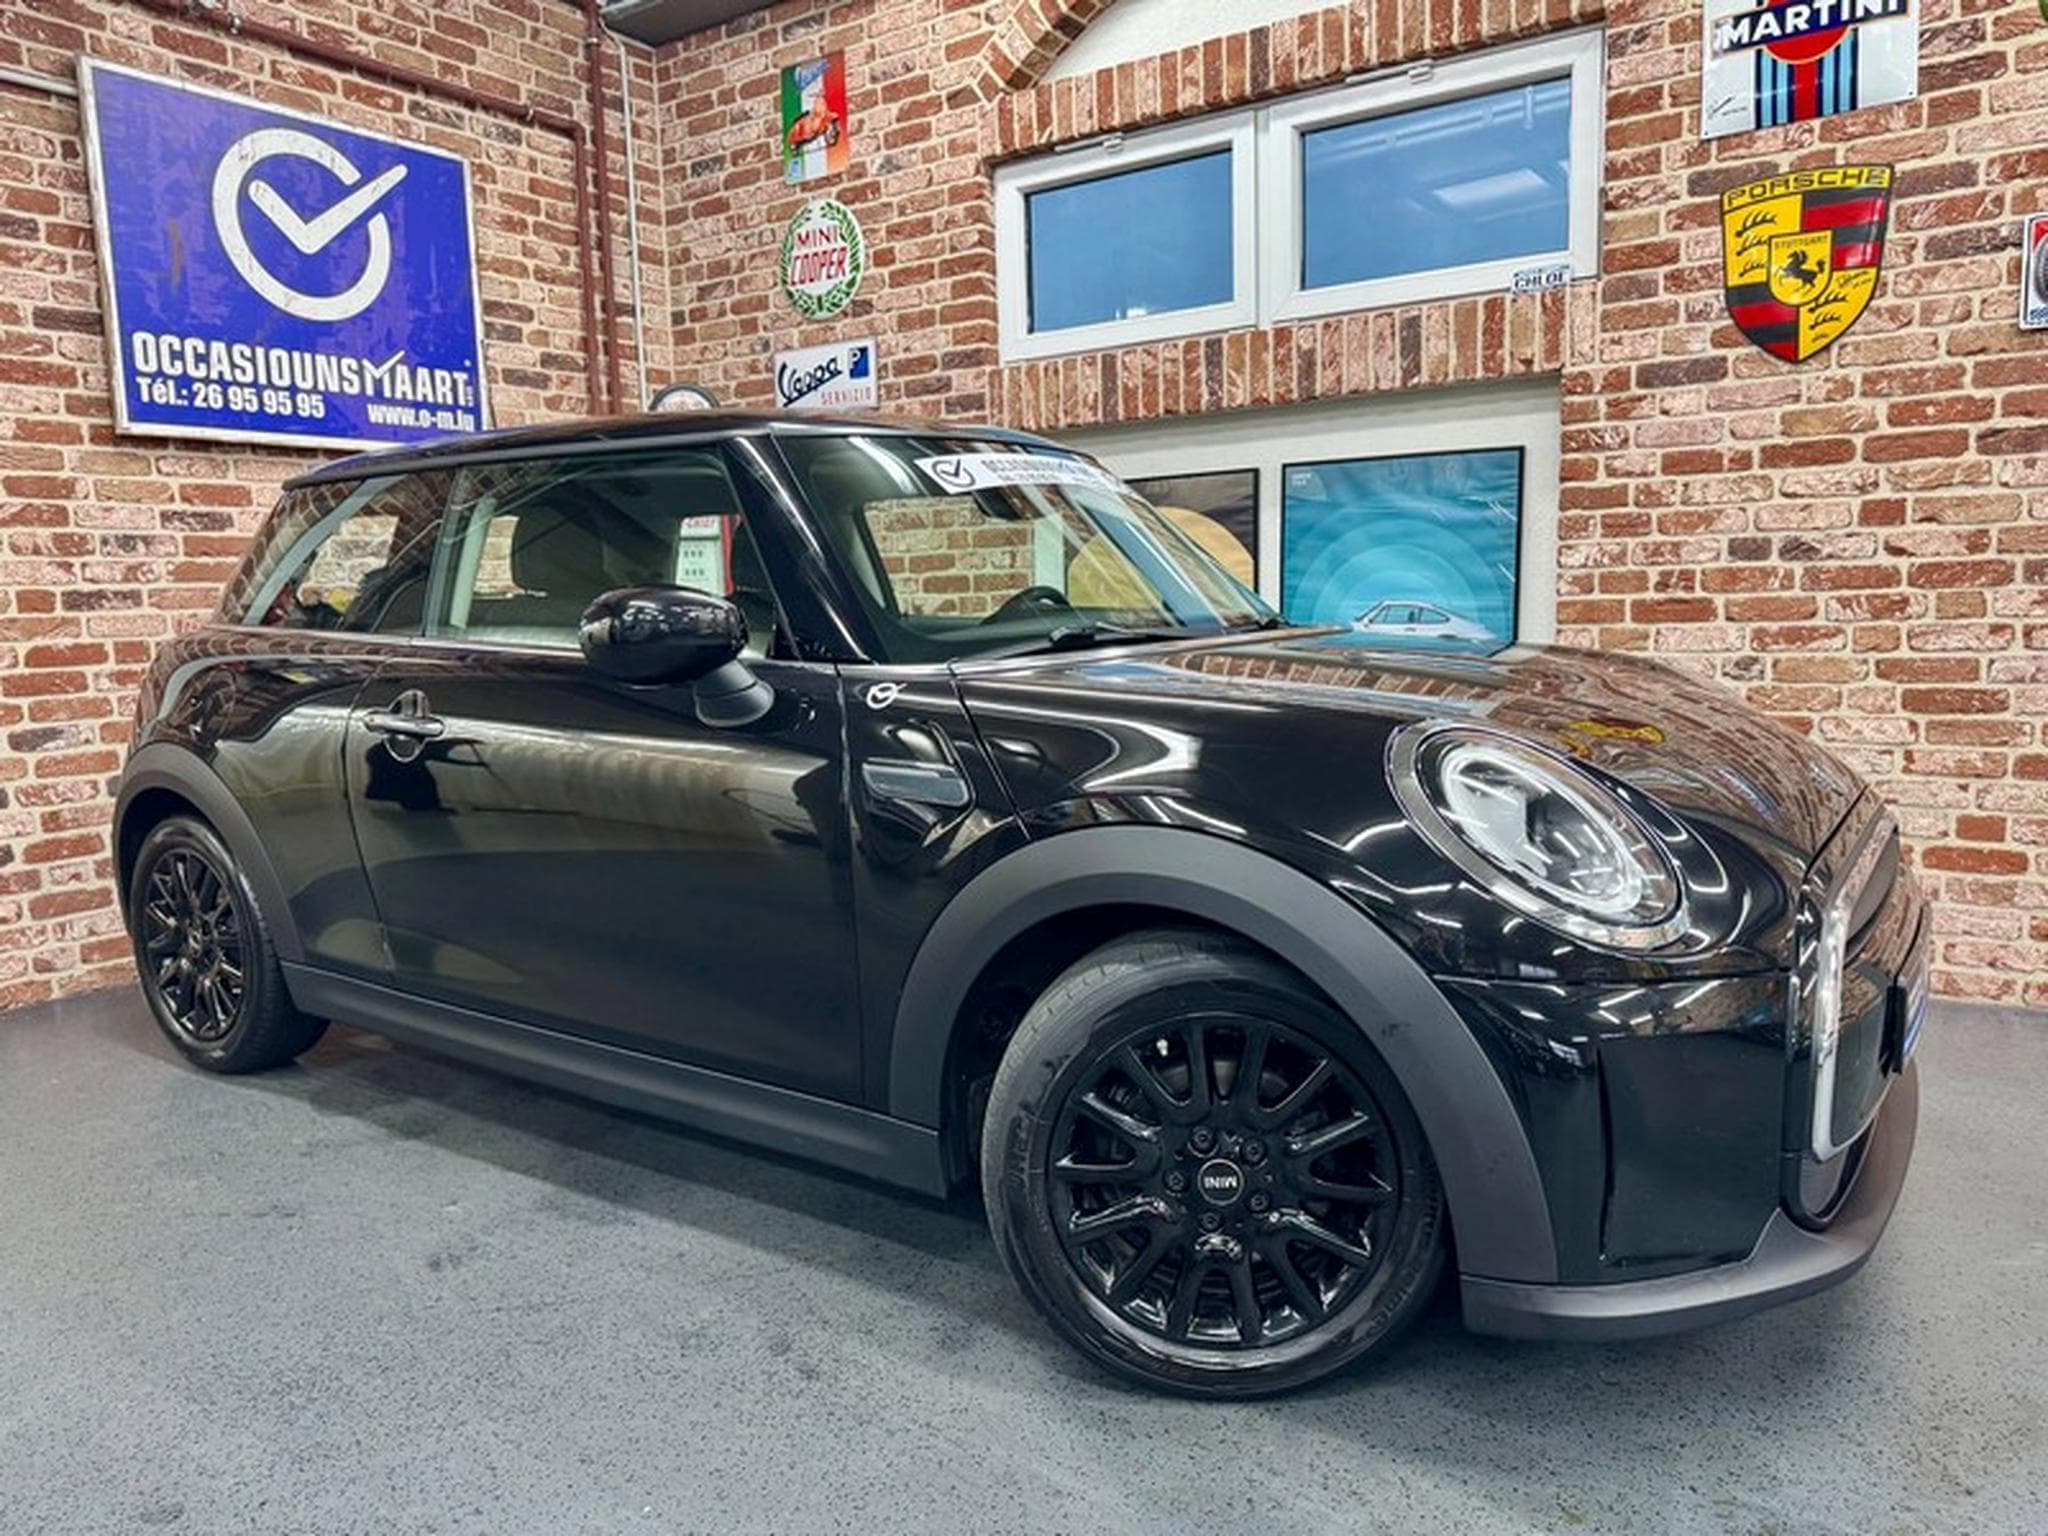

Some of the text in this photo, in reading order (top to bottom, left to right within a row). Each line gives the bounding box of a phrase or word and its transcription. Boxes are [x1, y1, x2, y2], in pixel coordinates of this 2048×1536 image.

[1727, 168, 1887, 207] PORSCHE
[796, 225, 838, 249] MINI
[790, 245, 848, 287] COOPER
[132, 331, 469, 406] OCCASIOUNSMAART
[778, 356, 843, 408] Vespa
[136, 375, 326, 419] Tél.: 26 95 95 95
[366, 403, 475, 432] www.o-m.lu
[1203, 1175, 1238, 1189] MINI
